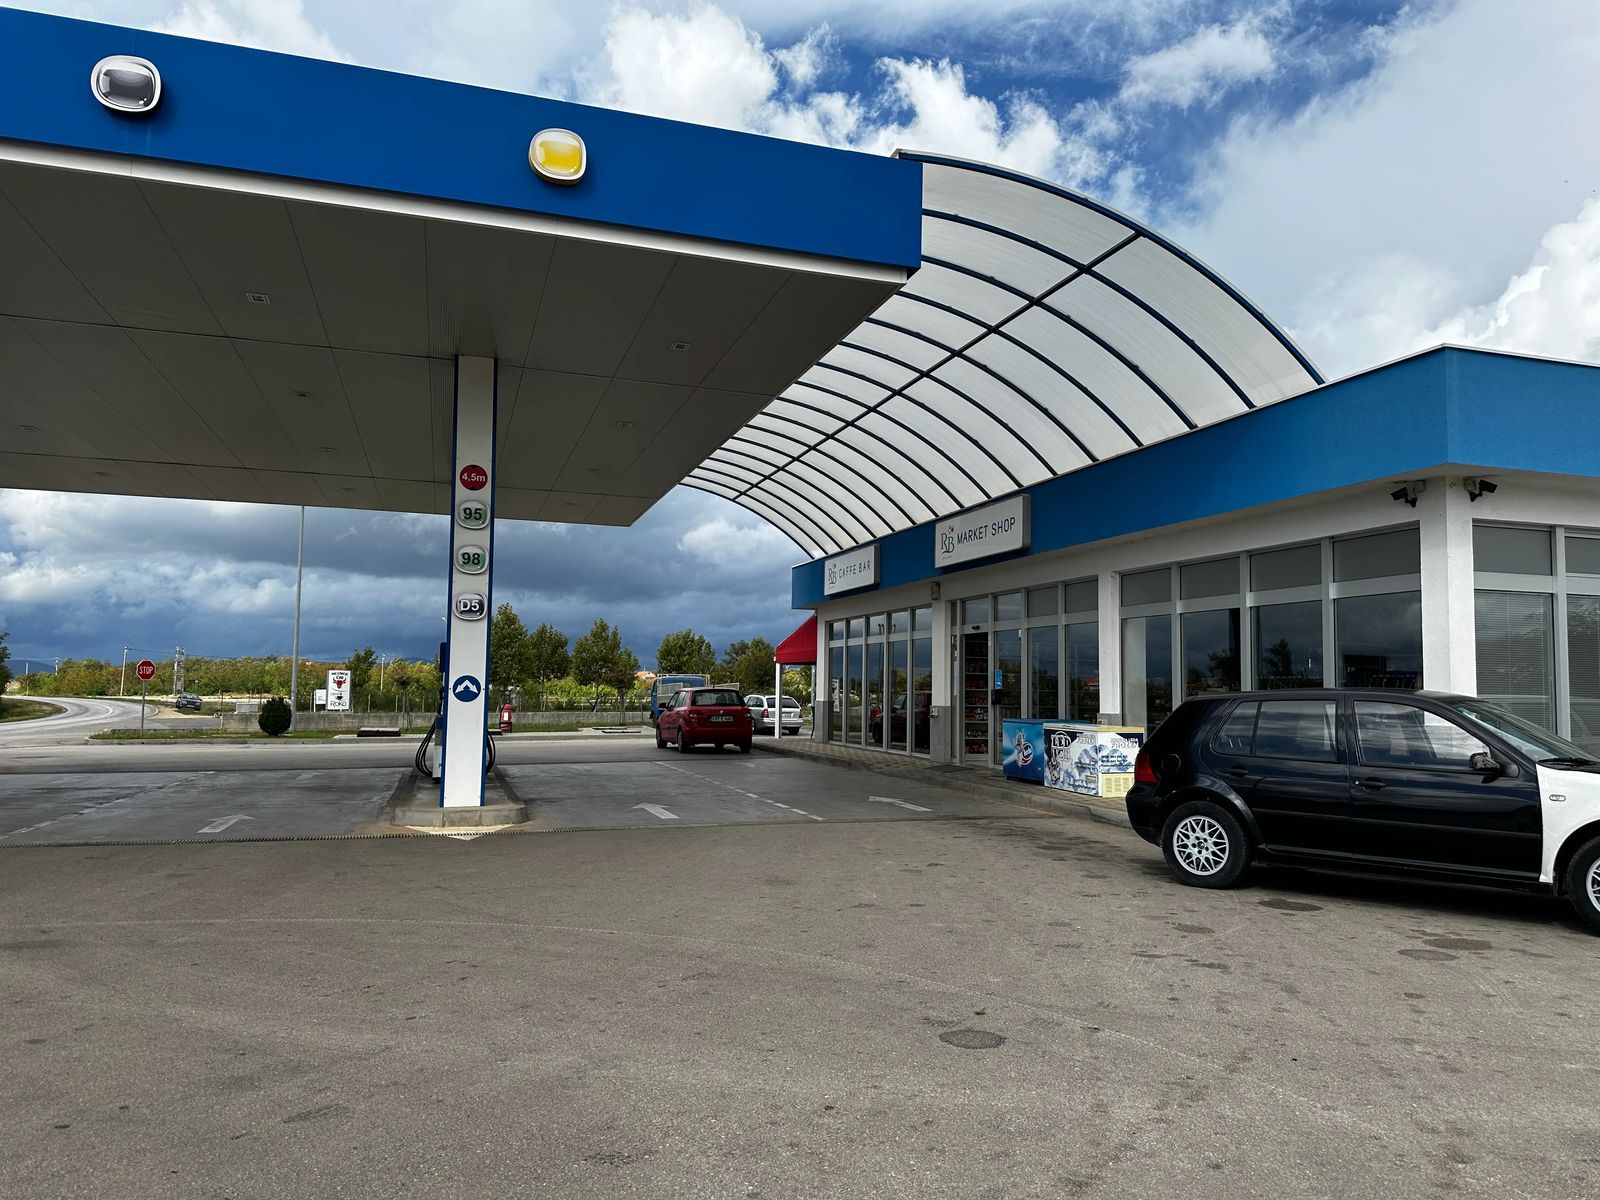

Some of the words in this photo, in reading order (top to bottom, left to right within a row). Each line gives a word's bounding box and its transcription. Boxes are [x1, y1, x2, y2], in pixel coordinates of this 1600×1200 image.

[463, 507, 483, 521] 95
[957, 525, 989, 545] MARKET
[991, 517, 1016, 536] SHOP
[461, 552, 481, 566] 98
[838, 564, 857, 578] CAFFE
[858, 560, 871, 573] BAR
[460, 598, 480, 612] D5
[139, 666, 154, 675] STOP
